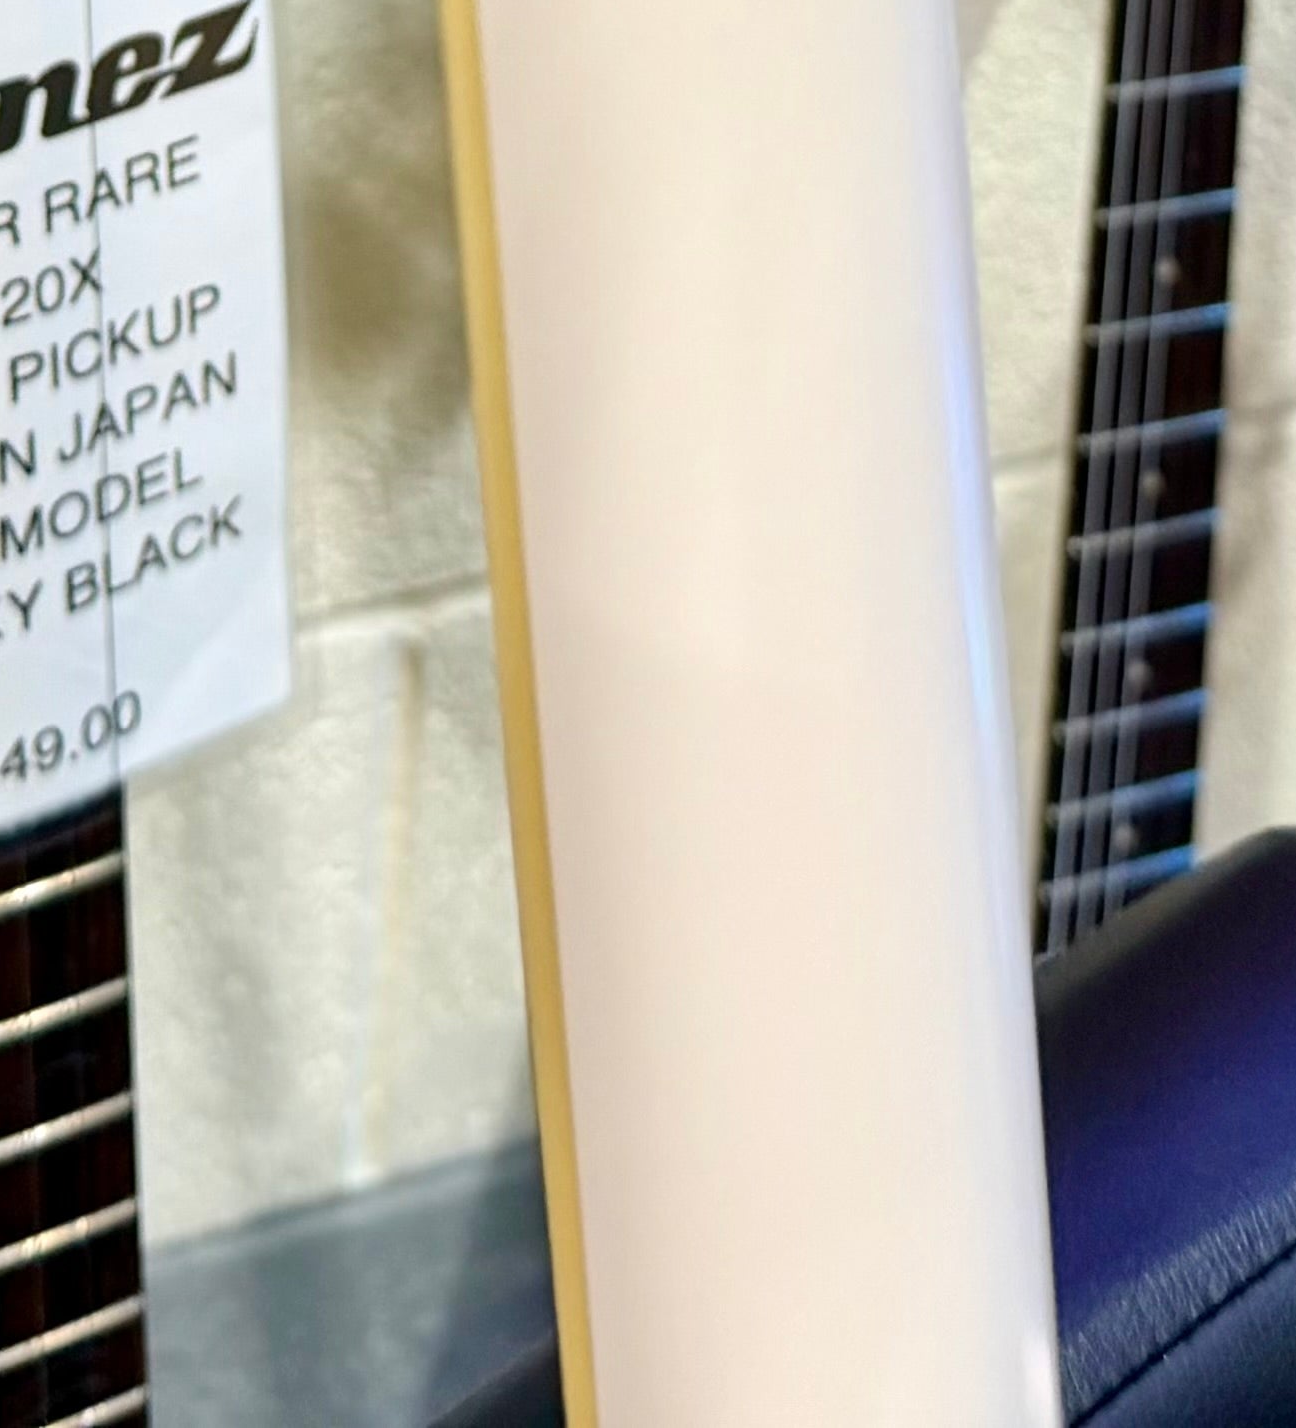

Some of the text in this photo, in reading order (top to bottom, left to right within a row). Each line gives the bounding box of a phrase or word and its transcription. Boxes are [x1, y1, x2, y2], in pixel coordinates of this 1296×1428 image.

[44, 135, 201, 234] RARE
[9, 284, 221, 404] PICKUP
[58, 351, 238, 463] JAPAN
[2, 448, 203, 563] MODEL
[67, 494, 244, 613] BLACK
